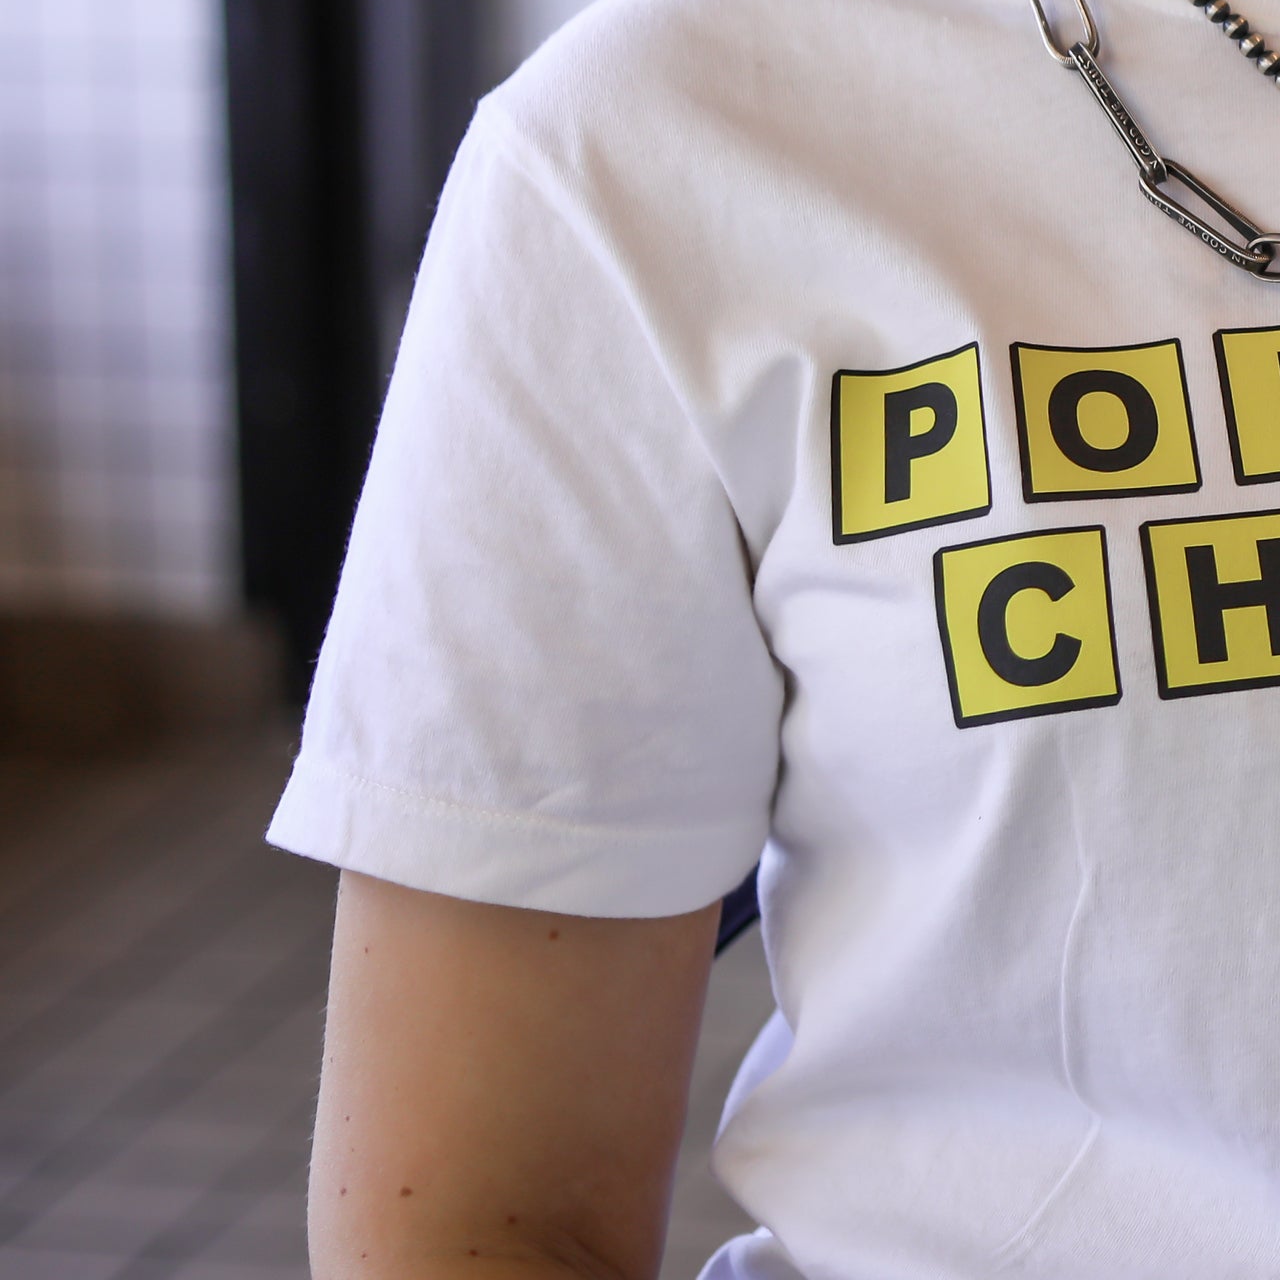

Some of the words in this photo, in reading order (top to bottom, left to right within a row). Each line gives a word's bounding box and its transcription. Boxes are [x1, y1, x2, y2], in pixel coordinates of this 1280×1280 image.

[1111, 101, 1127, 125] WE
[1177, 215, 1198, 235] WE
[1231, 252, 1247, 266] IN
